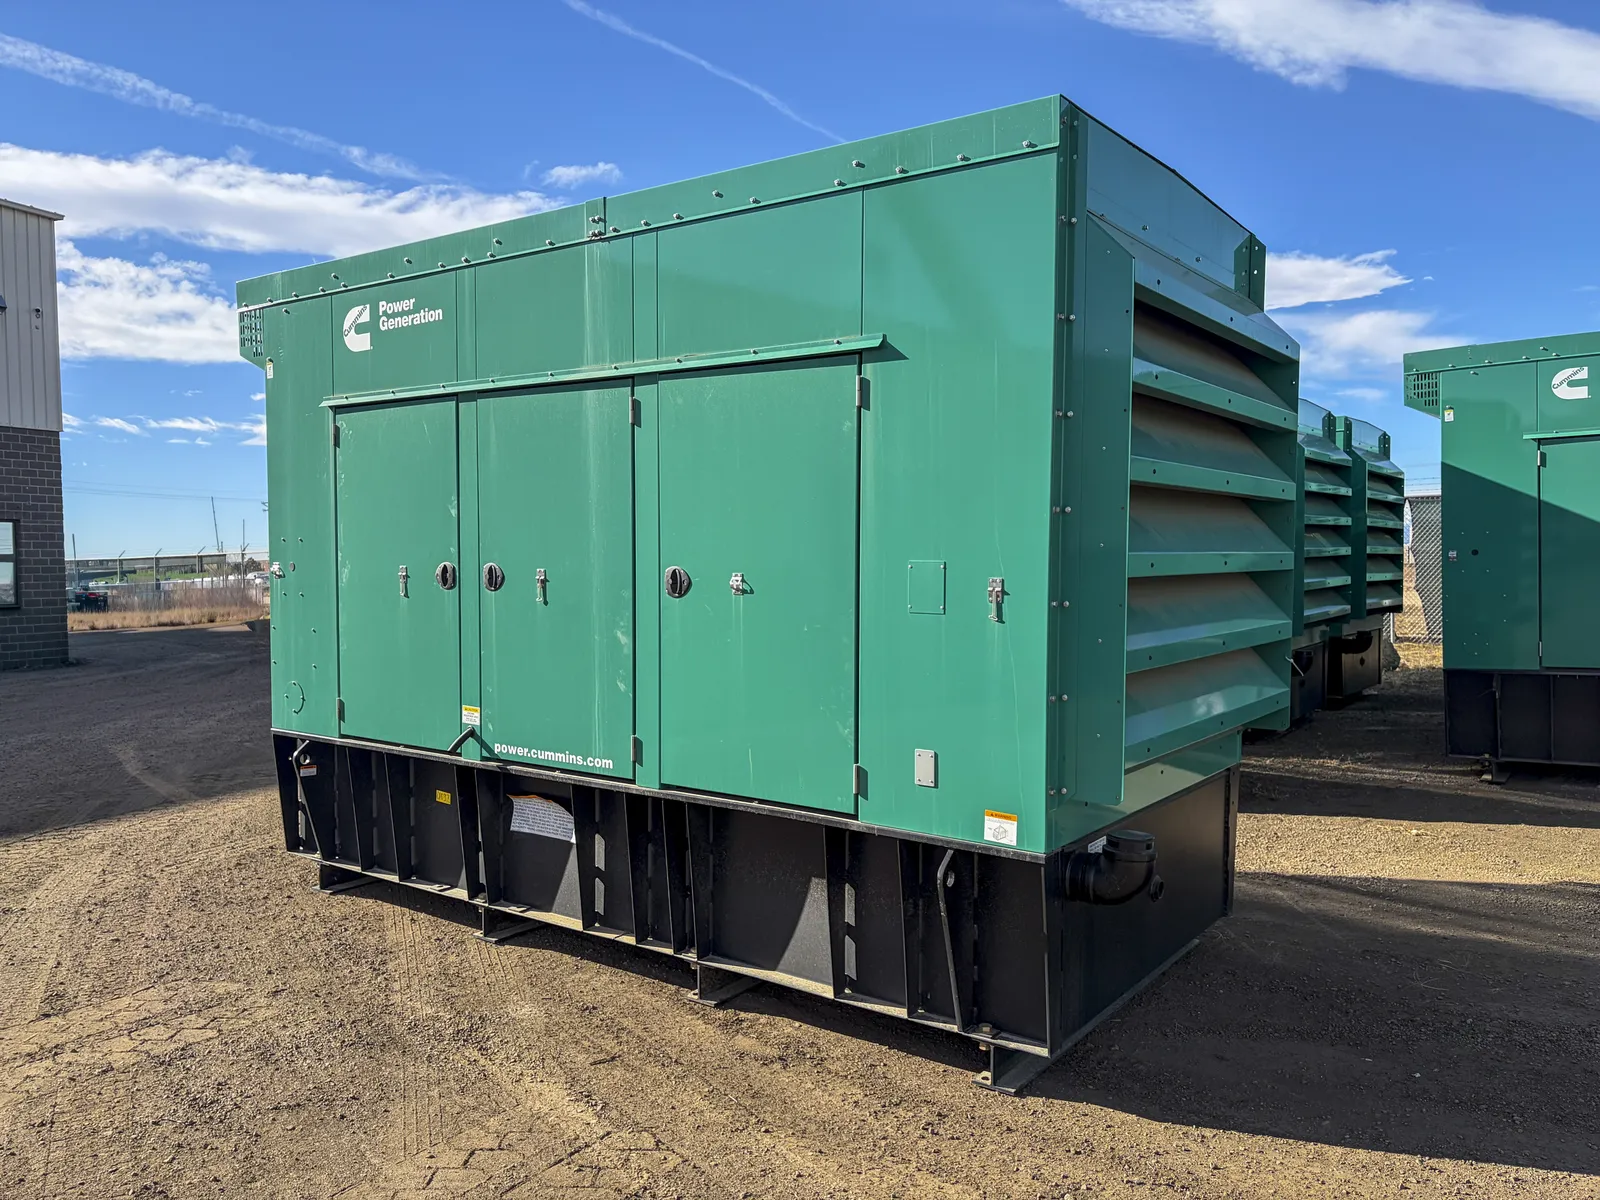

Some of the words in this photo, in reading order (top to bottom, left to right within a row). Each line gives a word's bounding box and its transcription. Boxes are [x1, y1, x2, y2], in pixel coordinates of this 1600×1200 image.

[379, 298, 415, 316] Power
[343, 305, 368, 337] Cummins
[379, 308, 443, 331] Generation
[1552, 367, 1585, 390] Cummins
[494, 743, 613, 769] power.cummins.com
